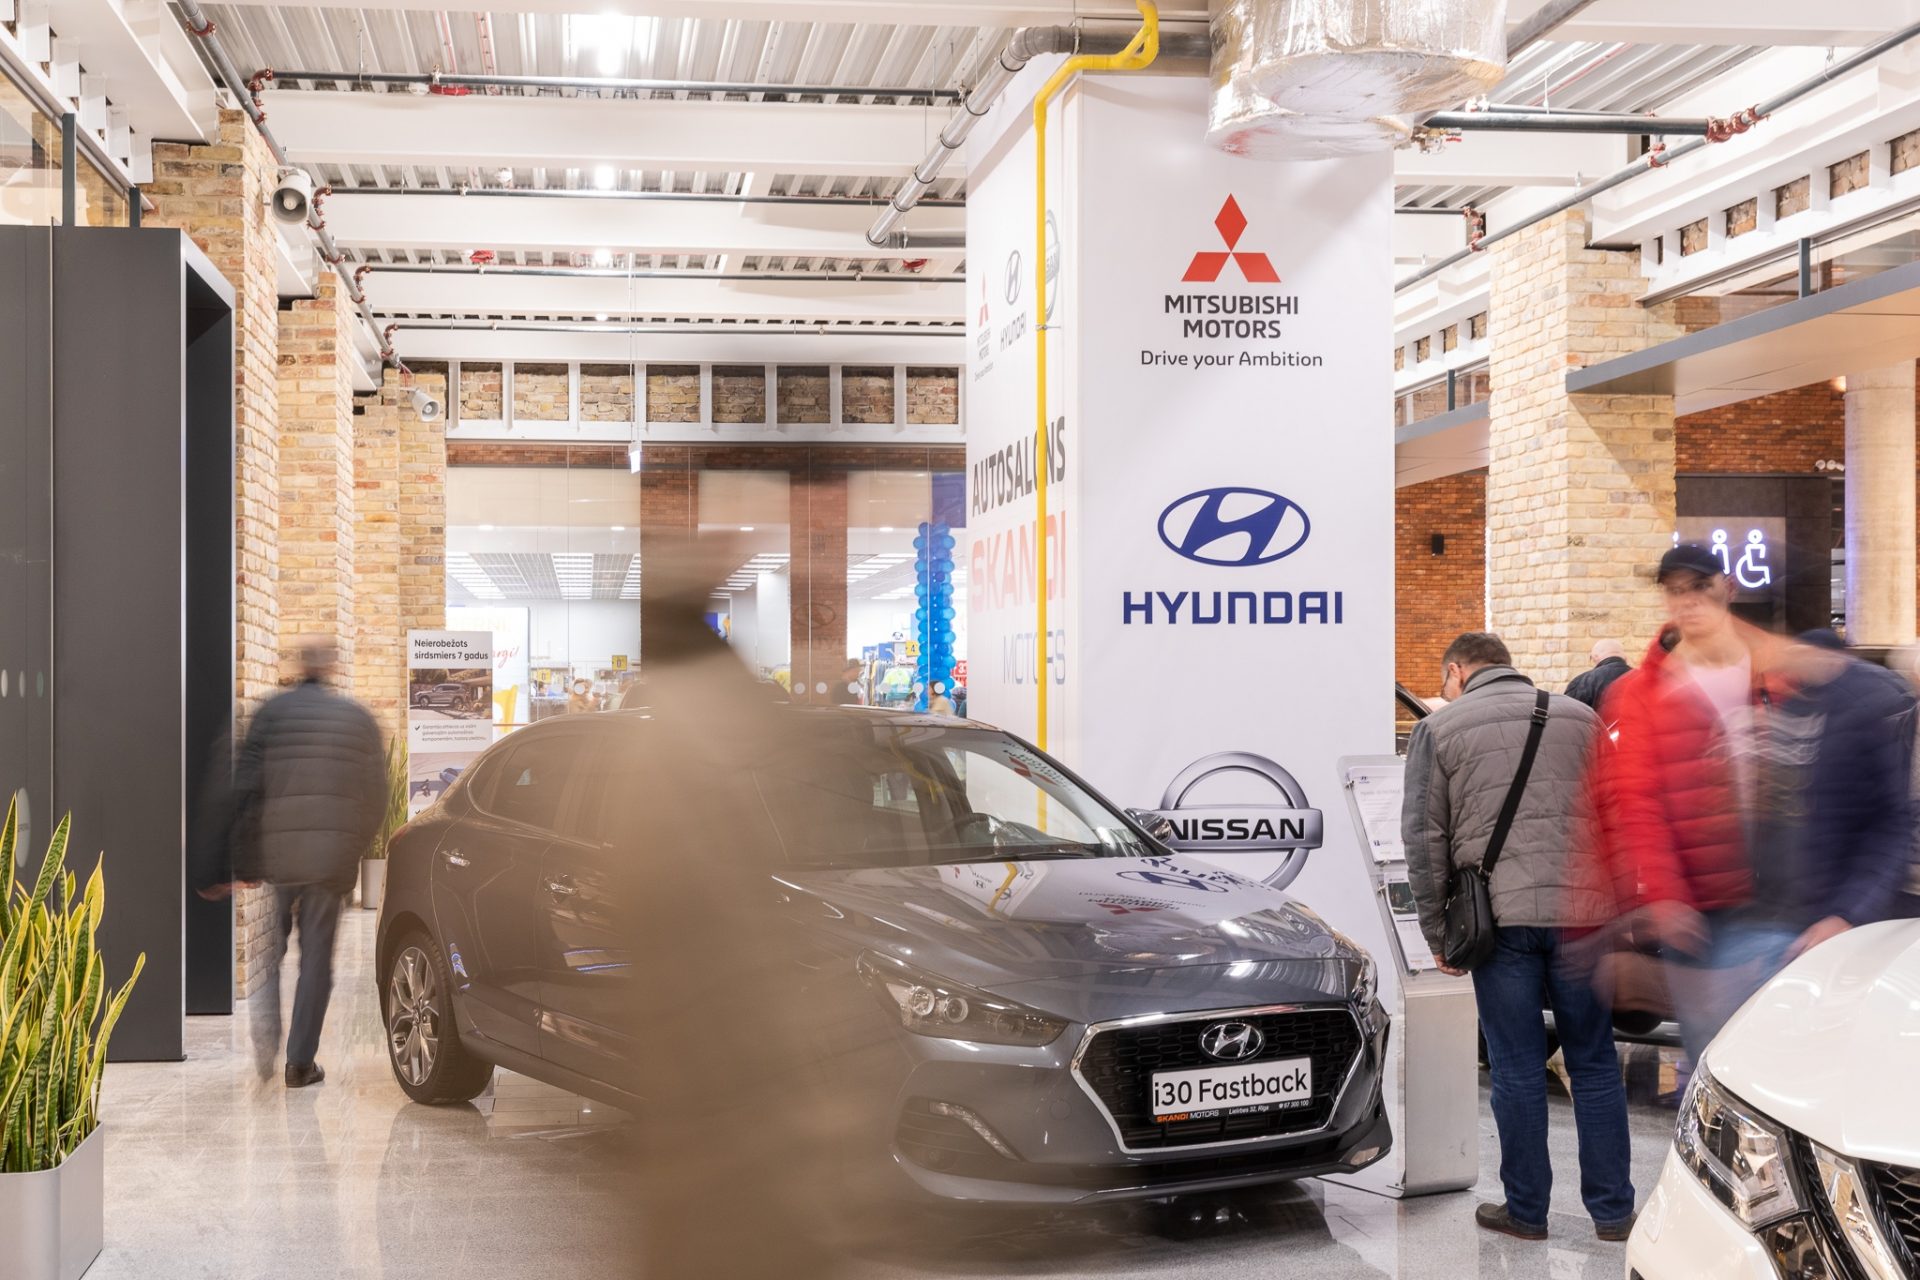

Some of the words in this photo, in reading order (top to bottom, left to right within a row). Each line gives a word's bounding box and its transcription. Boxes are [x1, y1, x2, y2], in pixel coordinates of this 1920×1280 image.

[1164, 295, 1298, 315] MITSUBISHI
[1000, 311, 1027, 352] HYUNDAI
[1183, 320, 1281, 339] MOTORS
[1141, 350, 1188, 367] Drive
[1193, 355, 1234, 370] your
[1239, 350, 1323, 367] Ambition
[971, 510, 1067, 613] SKANDI
[1123, 591, 1342, 624] HYUNDAI
[414, 639, 468, 648] Neierobežots
[414, 651, 456, 660] sirdsmiers
[458, 651, 463, 660] 7
[464, 651, 489, 661] gadus
[1167, 818, 1305, 840] NISSAN
[1154, 1081, 1192, 1107] i30
[1198, 1068, 1308, 1103] Fastback
[1156, 1113, 1189, 1123] SKANDI
[1190, 1109, 1219, 1119] MOTORS
